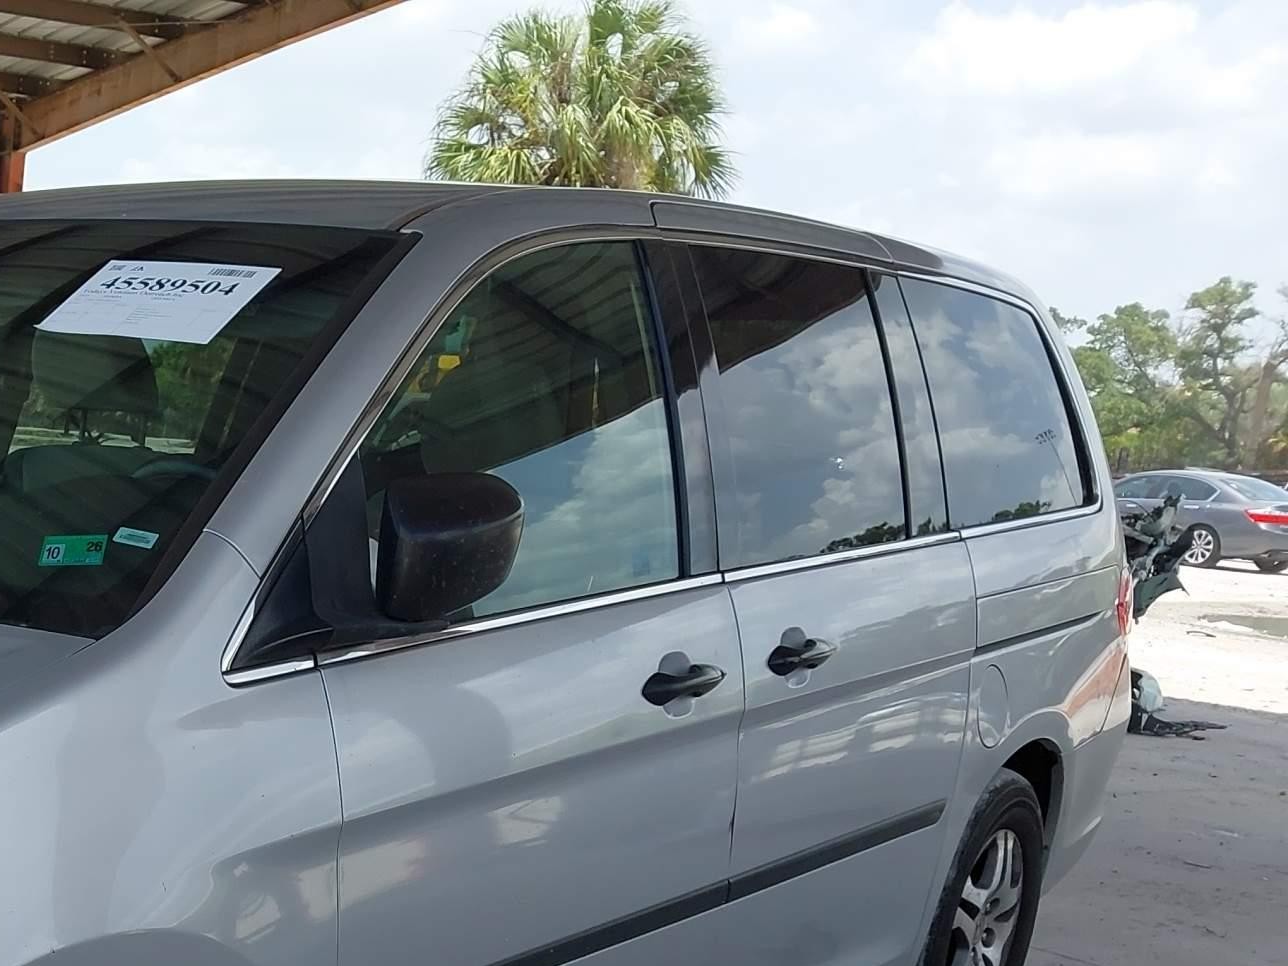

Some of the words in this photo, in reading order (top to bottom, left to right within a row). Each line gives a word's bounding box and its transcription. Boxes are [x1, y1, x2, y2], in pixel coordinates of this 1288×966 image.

[100, 275, 240, 296] 45589504
[46, 546, 60, 560] 10
[87, 541, 103, 552] 26
